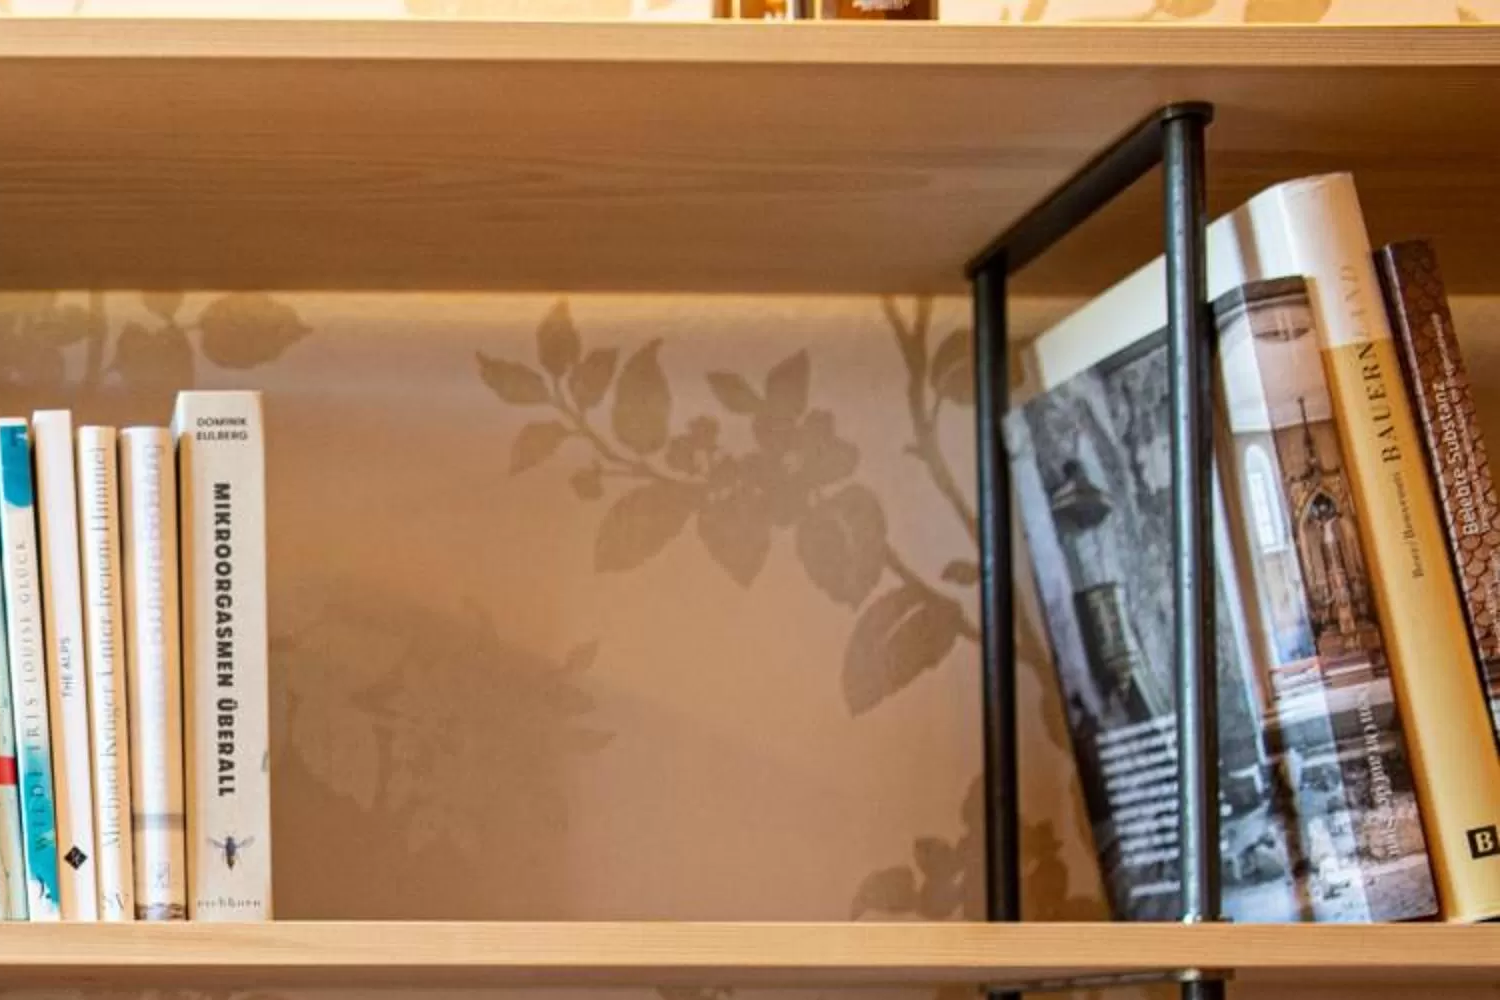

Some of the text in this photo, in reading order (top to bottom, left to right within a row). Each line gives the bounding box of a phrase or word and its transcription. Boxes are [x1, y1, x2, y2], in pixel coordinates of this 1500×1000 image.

[1339, 265, 1402, 464] BAUERNLAND
[196, 416, 247, 428] DOMINIK
[196, 431, 248, 441] EULBERG
[1432, 380, 1460, 464] Substanz
[1453, 466, 1480, 537] Belebte
[18, 615, 38, 684] LOUISE
[58, 636, 74, 698] THE ALPS
[213, 482, 239, 798] MIKROORGASMEN ÜBERALL
[21, 696, 41, 752] IRIS
[1474, 831, 1496, 854] B
